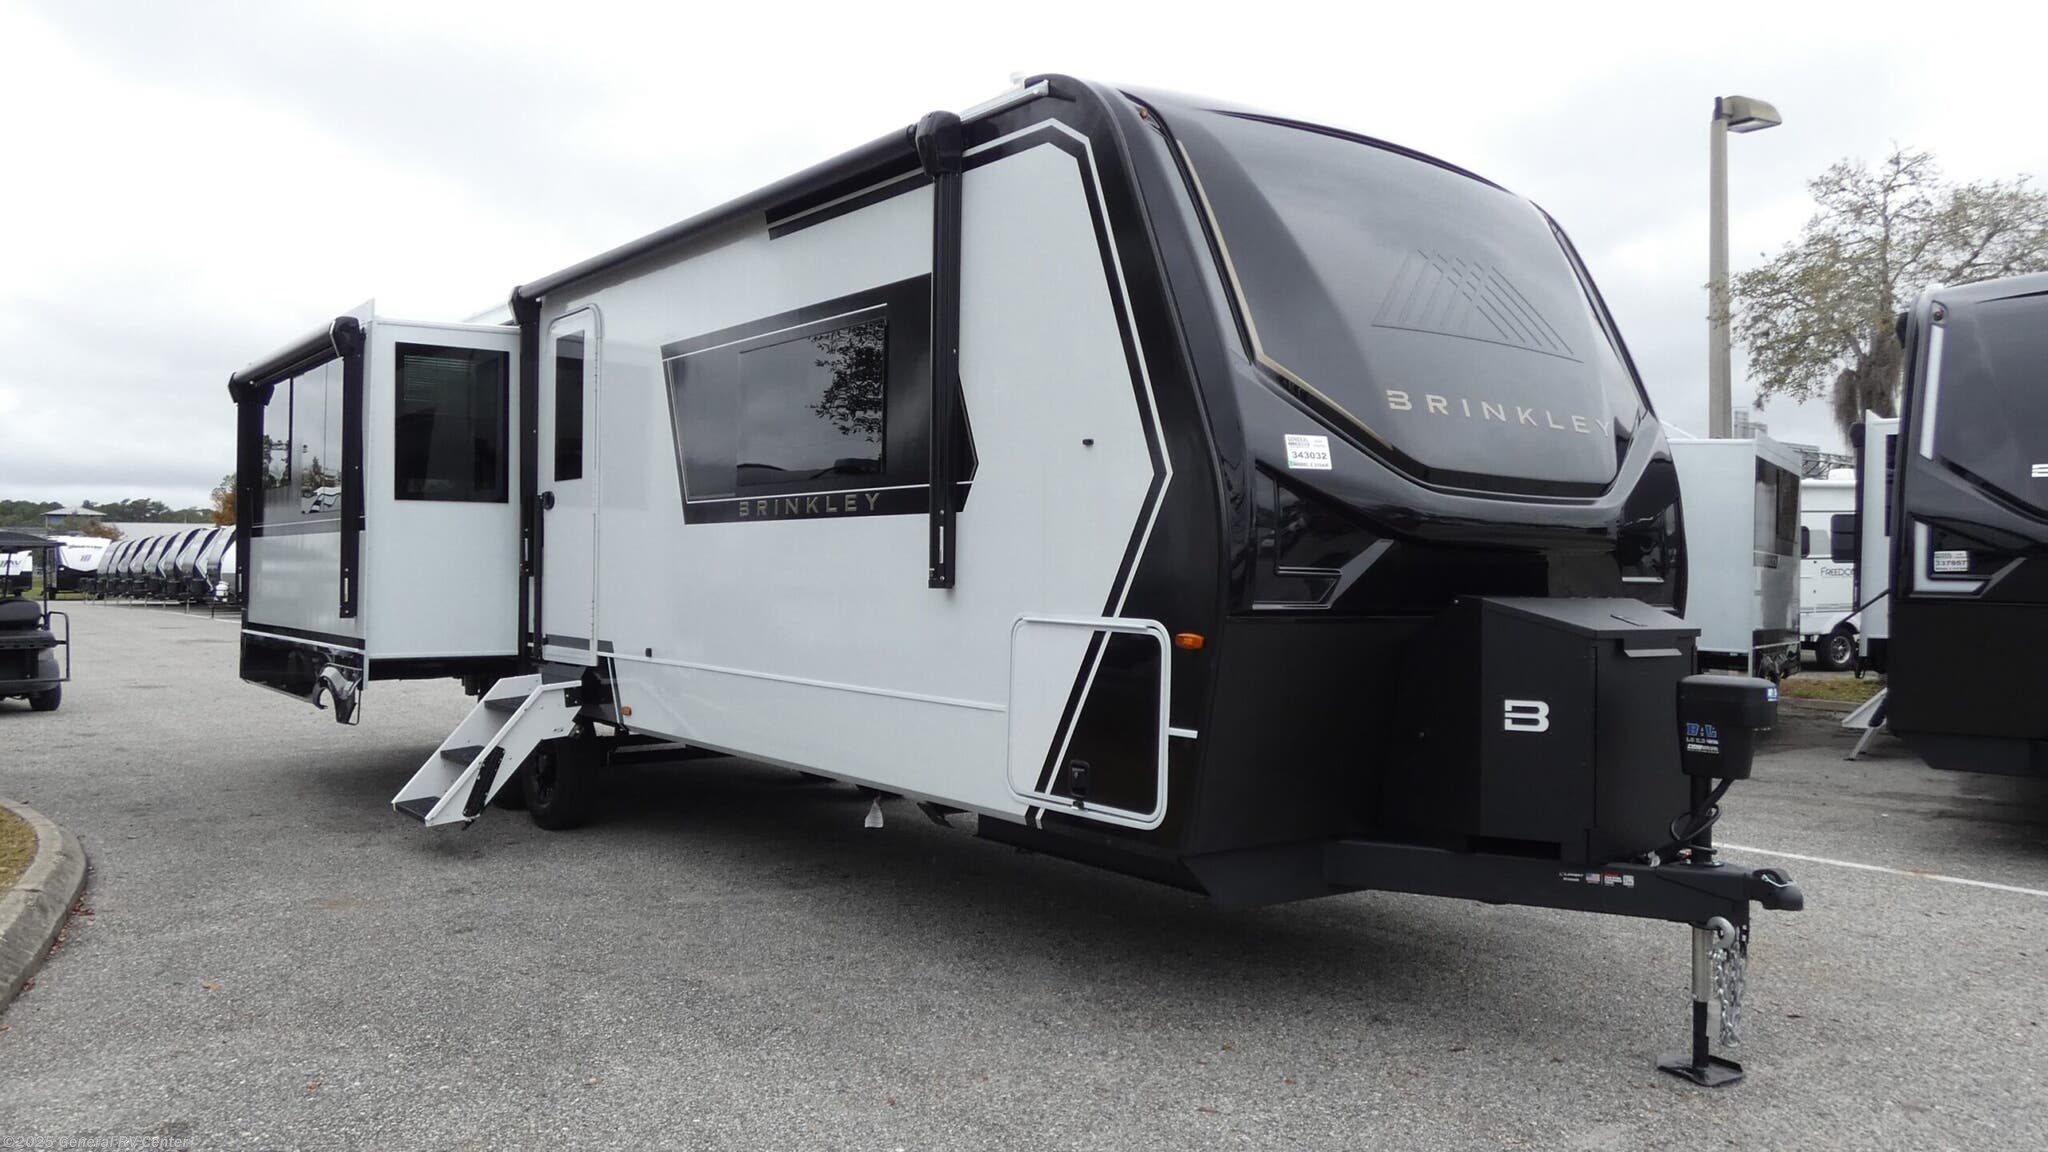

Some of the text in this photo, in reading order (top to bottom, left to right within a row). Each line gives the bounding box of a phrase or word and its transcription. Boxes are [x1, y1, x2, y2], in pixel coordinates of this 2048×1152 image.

[1386, 389, 1611, 437] BRINKLEY
[1291, 451, 1328, 460] 343032
[739, 493, 880, 517] BRINKLEY
[1504, 699, 1549, 732] B
